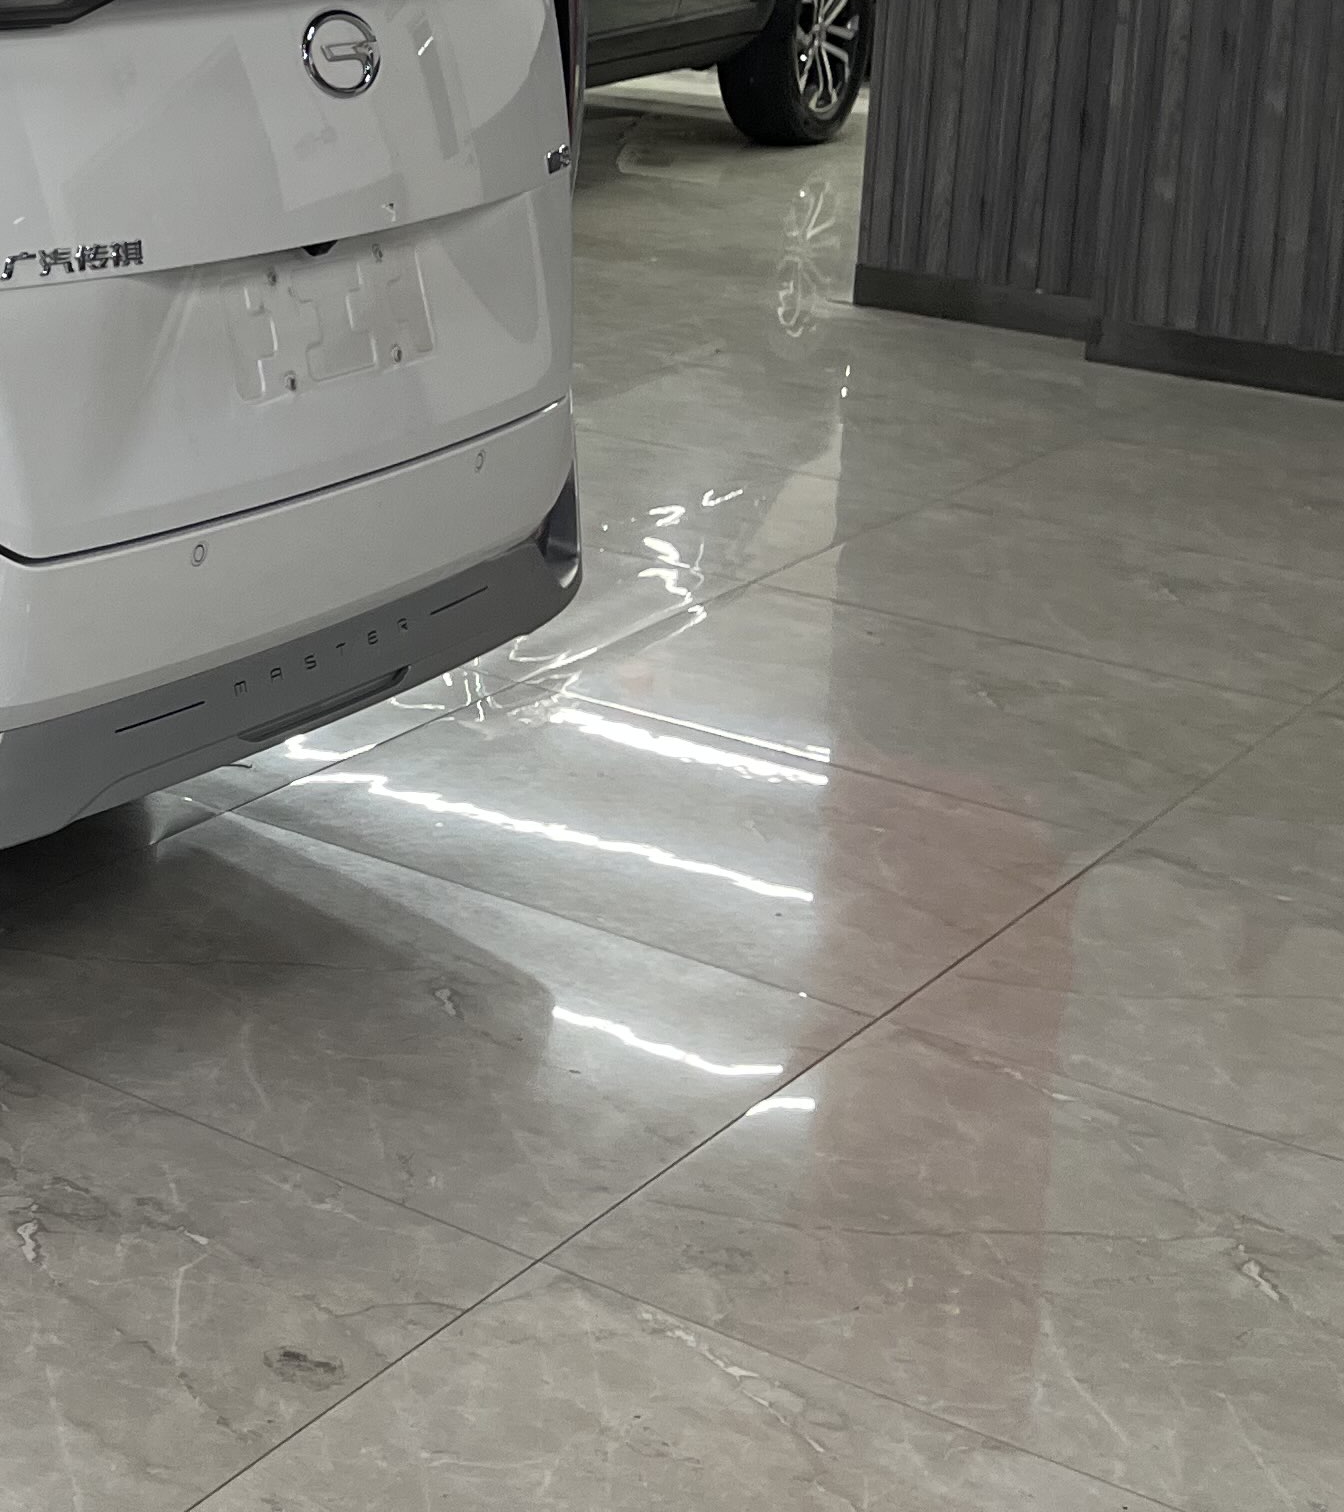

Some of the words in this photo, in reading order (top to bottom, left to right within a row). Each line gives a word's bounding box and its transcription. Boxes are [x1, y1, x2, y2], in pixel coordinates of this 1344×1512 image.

[0, 239, 144, 282] 广汽传祺
[233, 617, 409, 698] MASTER
